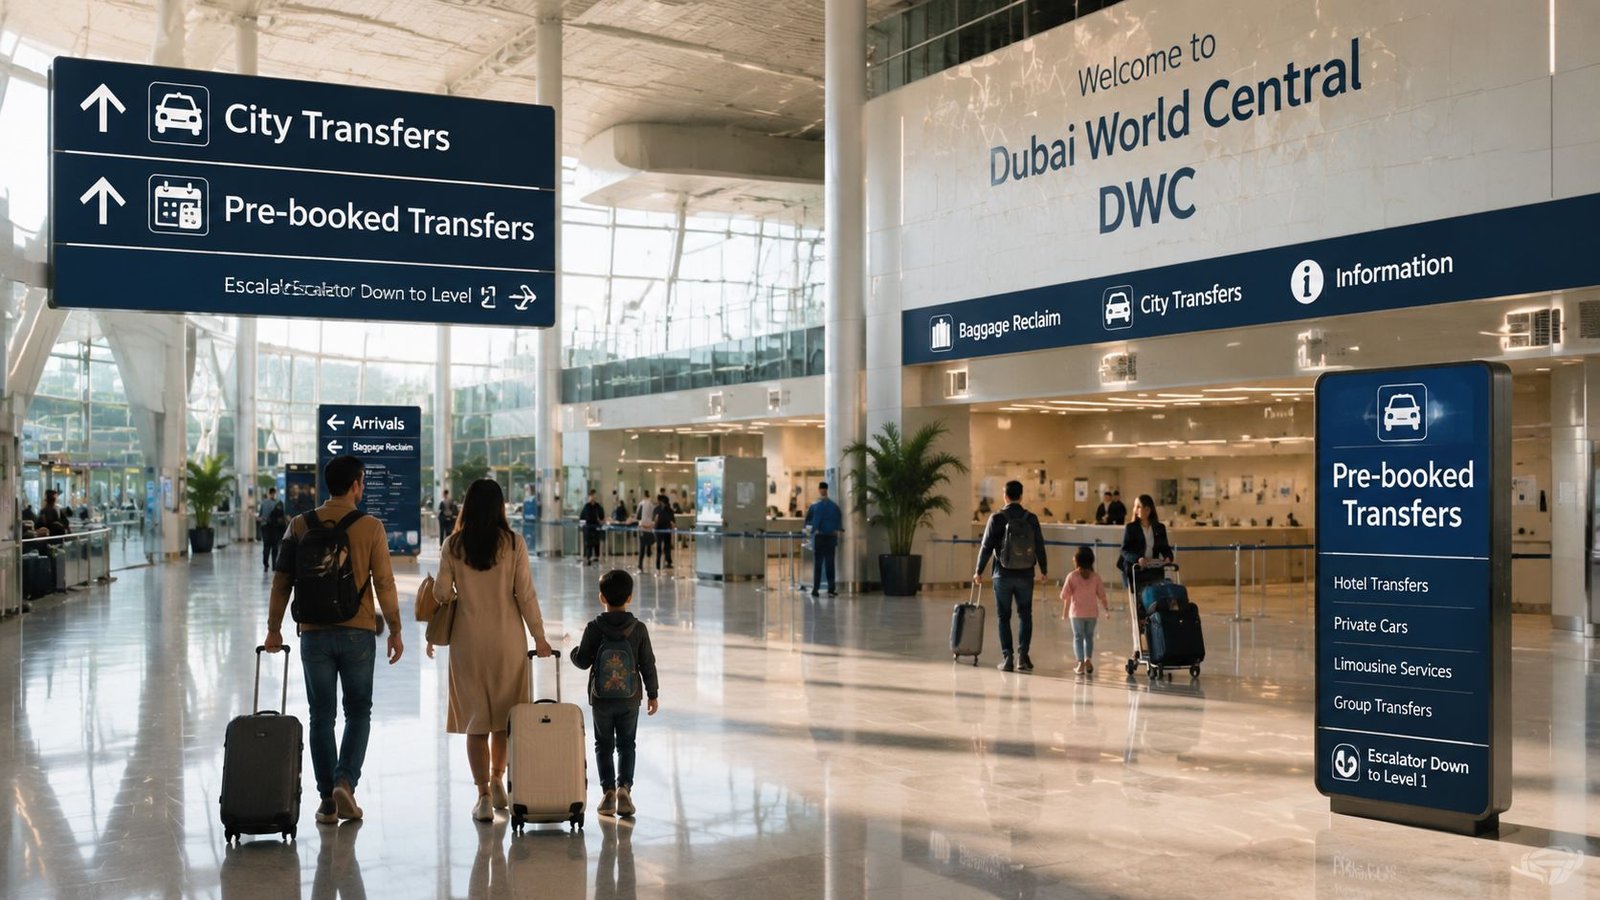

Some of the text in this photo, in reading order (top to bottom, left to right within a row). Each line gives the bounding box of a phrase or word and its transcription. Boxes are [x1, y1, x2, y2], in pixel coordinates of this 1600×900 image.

[1079, 34, 1215, 97] Welcome to
[991, 38, 1362, 187] Dubai World Central
[225, 104, 449, 151] City Transfers
[1100, 167, 1196, 234] DWC
[226, 196, 534, 240] Pre-booked Transfers
[1337, 254, 1452, 287] Information
[362, 284, 404, 299] Down
[409, 287, 426, 301] to
[433, 287, 471, 303] Level
[1141, 284, 1241, 315] City Transfers
[960, 310, 1060, 340] Baggage Reclaim
[352, 415, 405, 431] Arrivals
[1334, 460, 1473, 488] Pre-booked
[1343, 499, 1461, 527] Transfers
[1335, 577, 1428, 592] Hotel Transfers
[1335, 617, 1407, 633] Private Cars
[1335, 657, 1451, 678] Limousine Services
[1335, 696, 1432, 717] Group Transfers
[1368, 749, 1468, 773] Escalator Down
[1368, 769, 1427, 787] to Level 1
